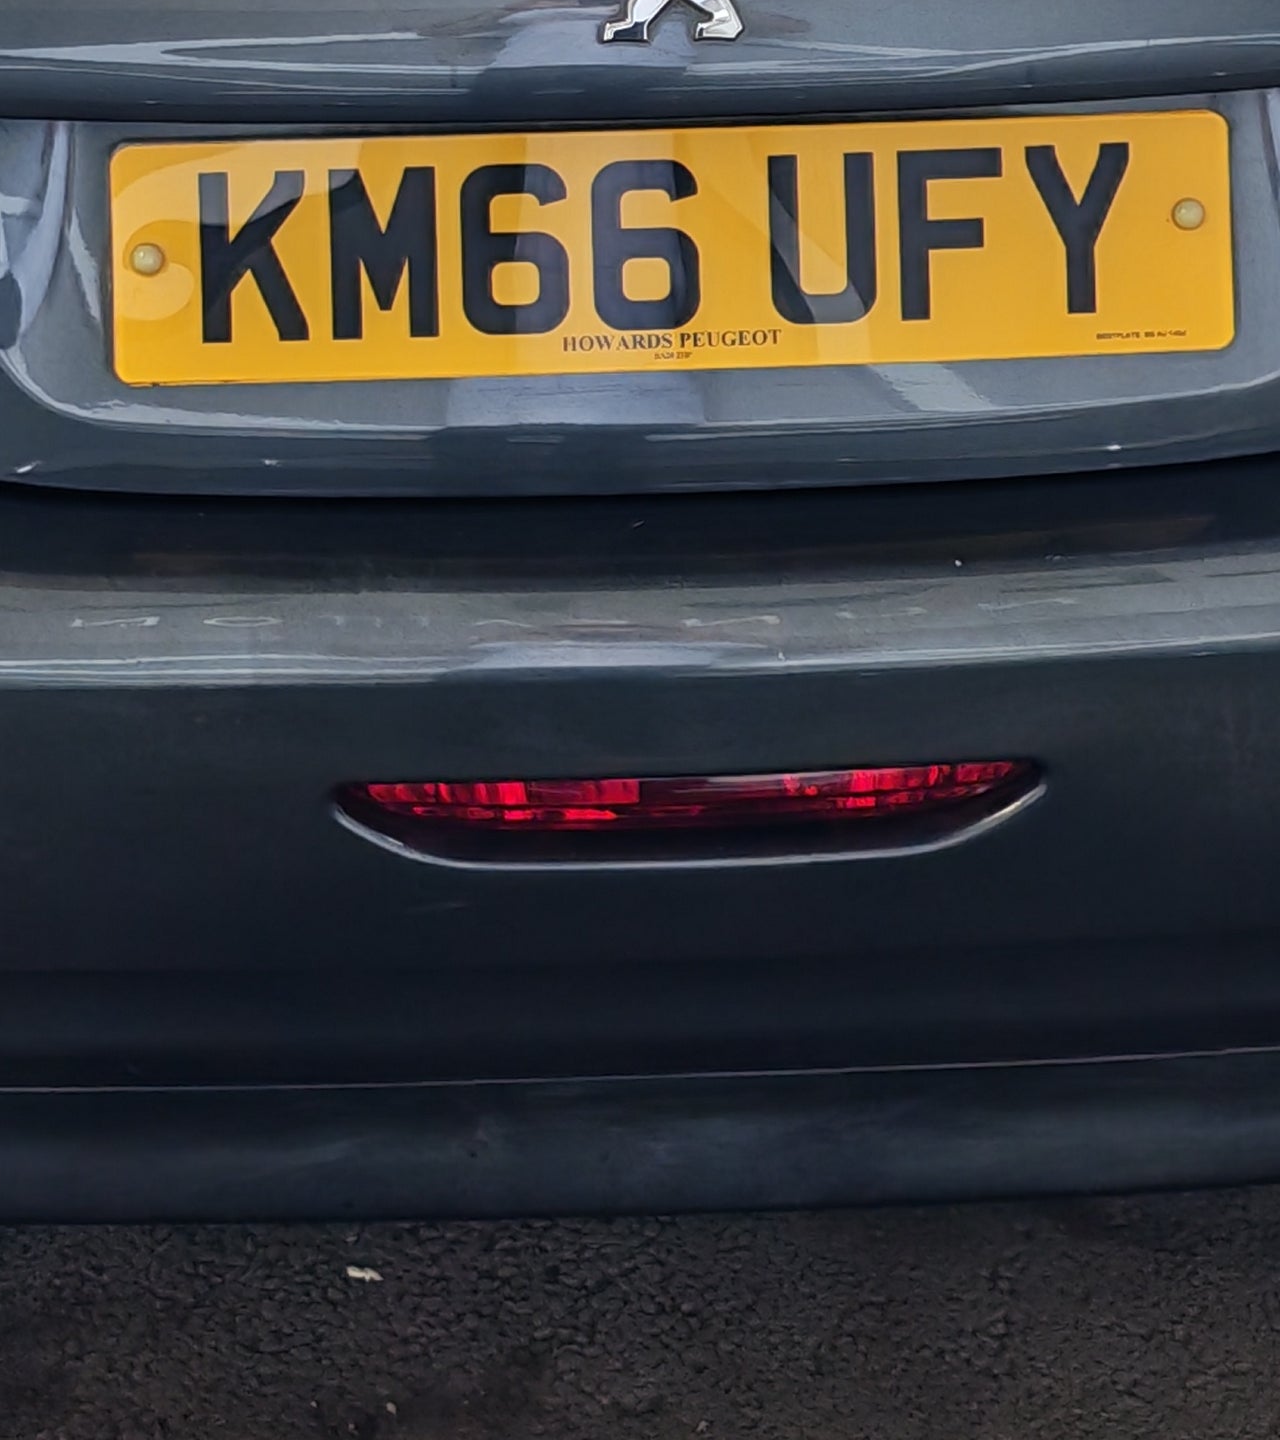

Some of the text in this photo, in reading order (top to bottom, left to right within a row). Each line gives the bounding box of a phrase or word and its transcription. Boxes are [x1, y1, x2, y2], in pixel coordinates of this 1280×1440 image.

[198, 142, 1130, 344] KM66 UFY
[562, 329, 782, 352] HOWARDS PEUGEOT
